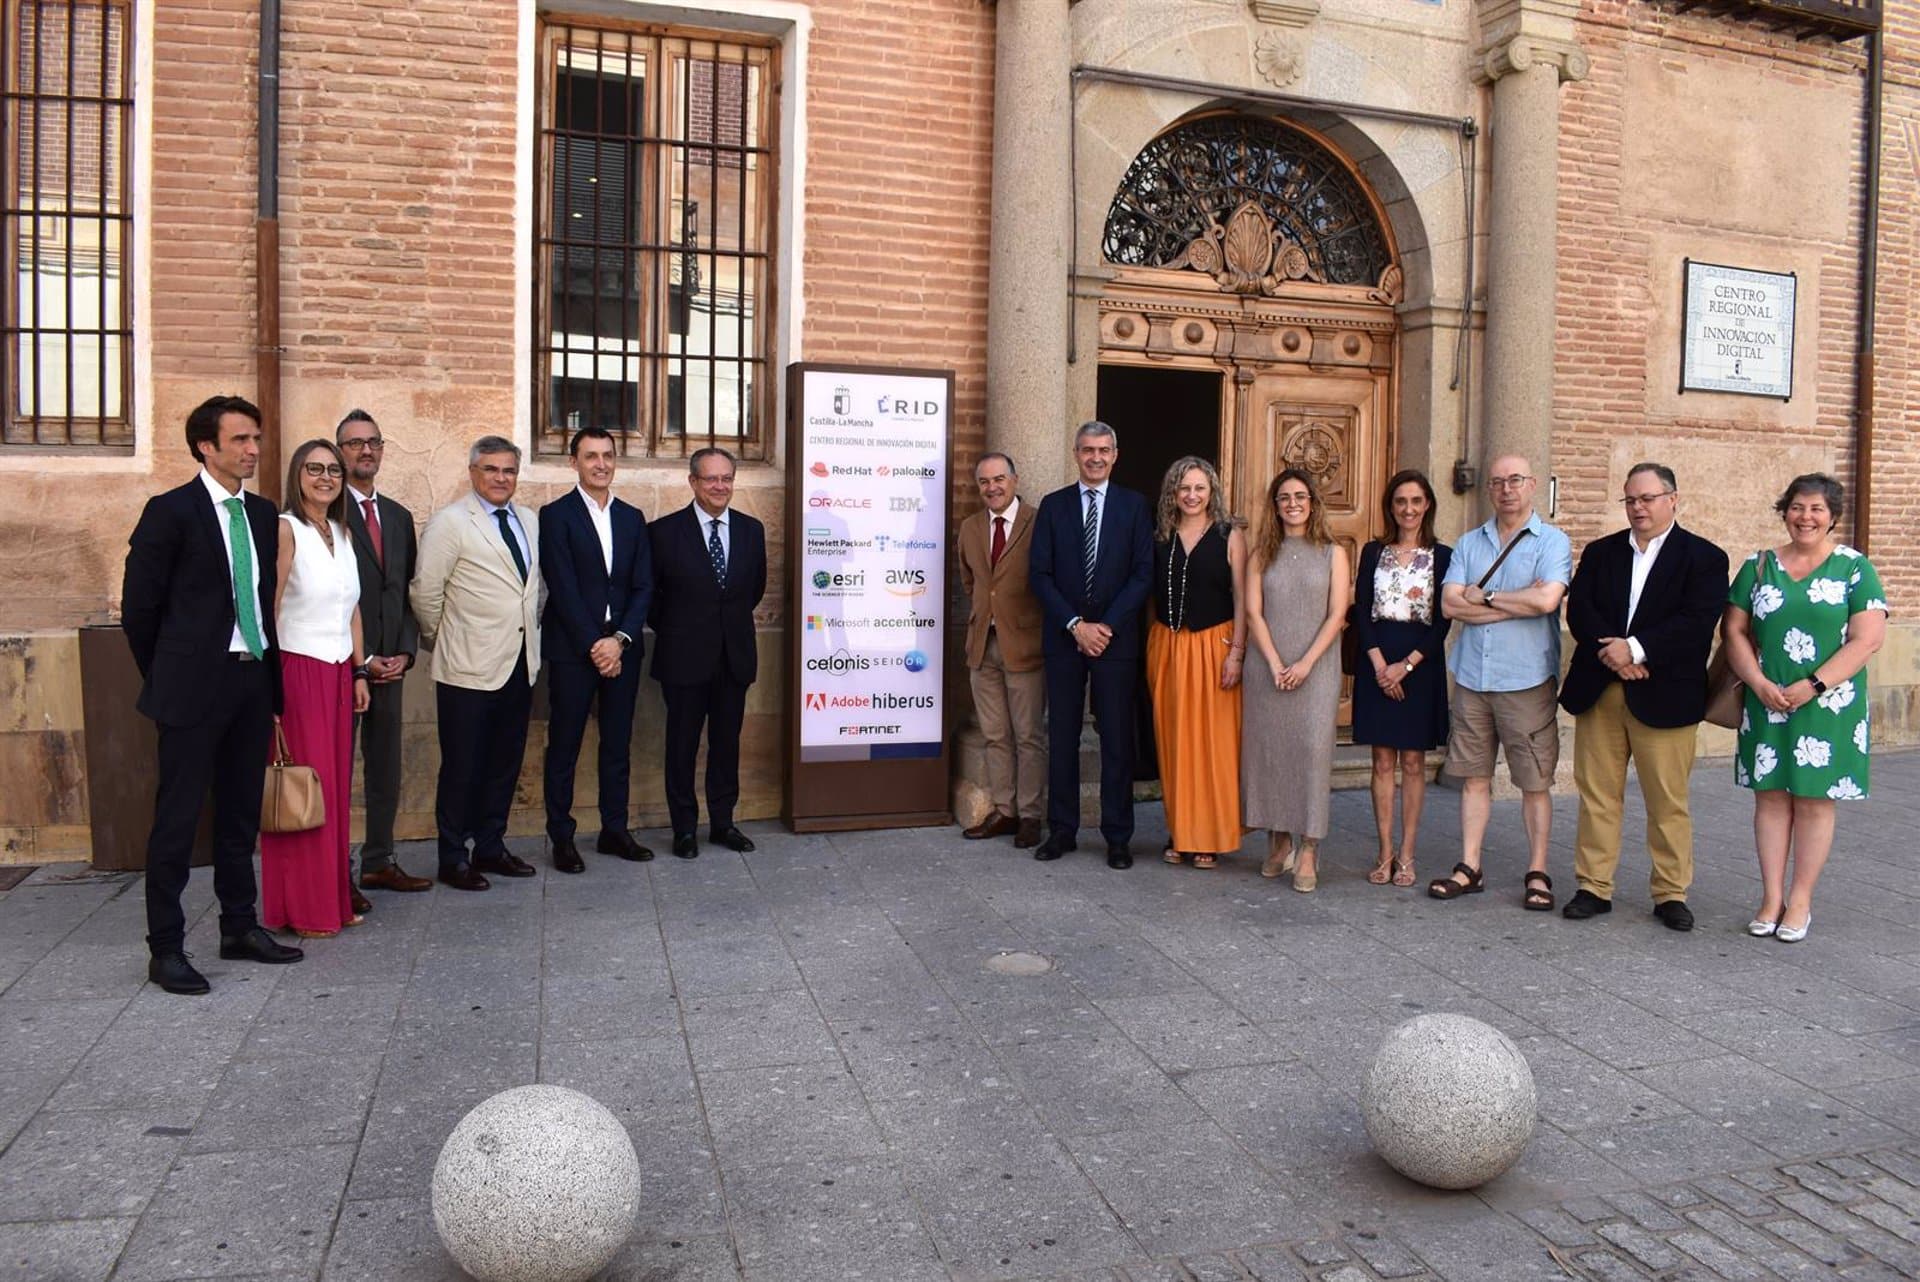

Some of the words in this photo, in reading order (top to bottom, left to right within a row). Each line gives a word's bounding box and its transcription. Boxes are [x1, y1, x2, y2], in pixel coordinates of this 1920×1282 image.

[1714, 285, 1766, 303] CENTRO
[1709, 300, 1773, 319] REGIONAL
[1735, 317, 1745, 327] DE
[1717, 343, 1764, 360] DIGITAL
[848, 418, 874, 427] Mancha
[809, 436, 834, 445] CENTRO
[836, 437, 865, 446] REGIONAL
[867, 438, 875, 447] DE
[915, 440, 937, 449] DIGITAL
[832, 465, 852, 475] Red
[854, 466, 872, 476] Hat
[893, 465, 936, 477] paloalto
[809, 497, 872, 508] ORACLE
[889, 496, 921, 512] IBM
[808, 539, 839, 547] Hewlett
[840, 539, 872, 548] Packard
[893, 540, 937, 549] Telefónica
[833, 570, 864, 586] esri
[885, 569, 925, 585] aws
[826, 617, 870, 628] Microsoft
[874, 617, 935, 628] accenture
[807, 655, 870, 670] celonis
[873, 656, 923, 666] SEIDOR
[831, 696, 870, 707] Adobe
[872, 693, 934, 709] hiberus
[839, 725, 901, 735] FORTINET
